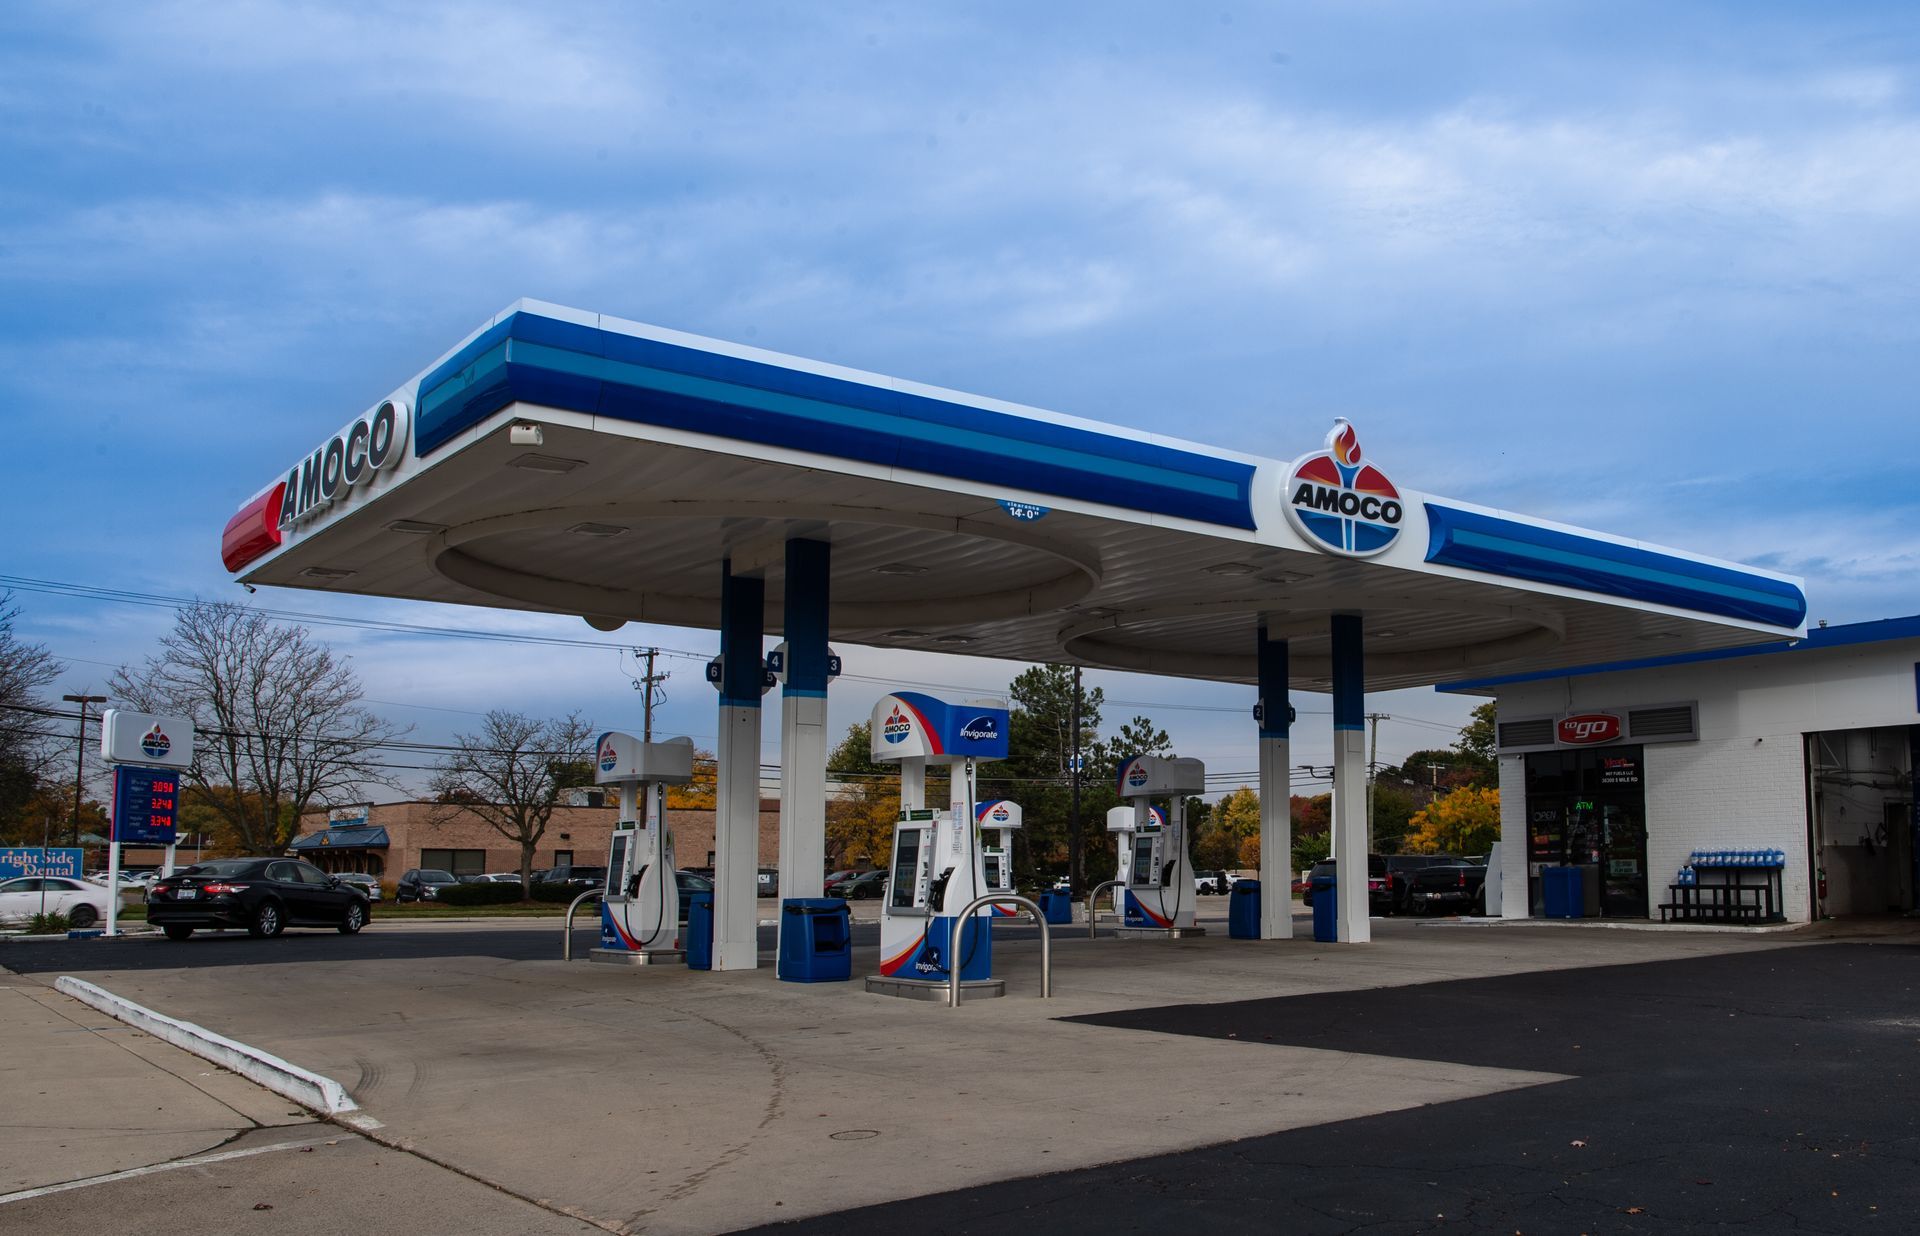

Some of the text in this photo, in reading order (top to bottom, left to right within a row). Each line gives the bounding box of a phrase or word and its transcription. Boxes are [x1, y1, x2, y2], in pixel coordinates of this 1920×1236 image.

[277, 399, 399, 530] AMOCO
[1291, 482, 1403, 526] AMOCO
[771, 655, 779, 667] 4
[830, 659, 837, 671] 3
[710, 665, 717, 677] 6
[766, 672, 773, 682] 5
[1255, 707, 1261, 717] 2
[884, 723, 911, 734] AMOCO
[960, 727, 998, 740] Invigorate
[1565, 720, 1608, 739] to go
[141, 740, 170, 749] AMOCO
[1575, 801, 1593, 810] ATM
[1534, 810, 1557, 822] OPEN
[42, 851, 74, 864] Side
[23, 863, 74, 876] Dental
[915, 961, 942, 973] Invigorae
